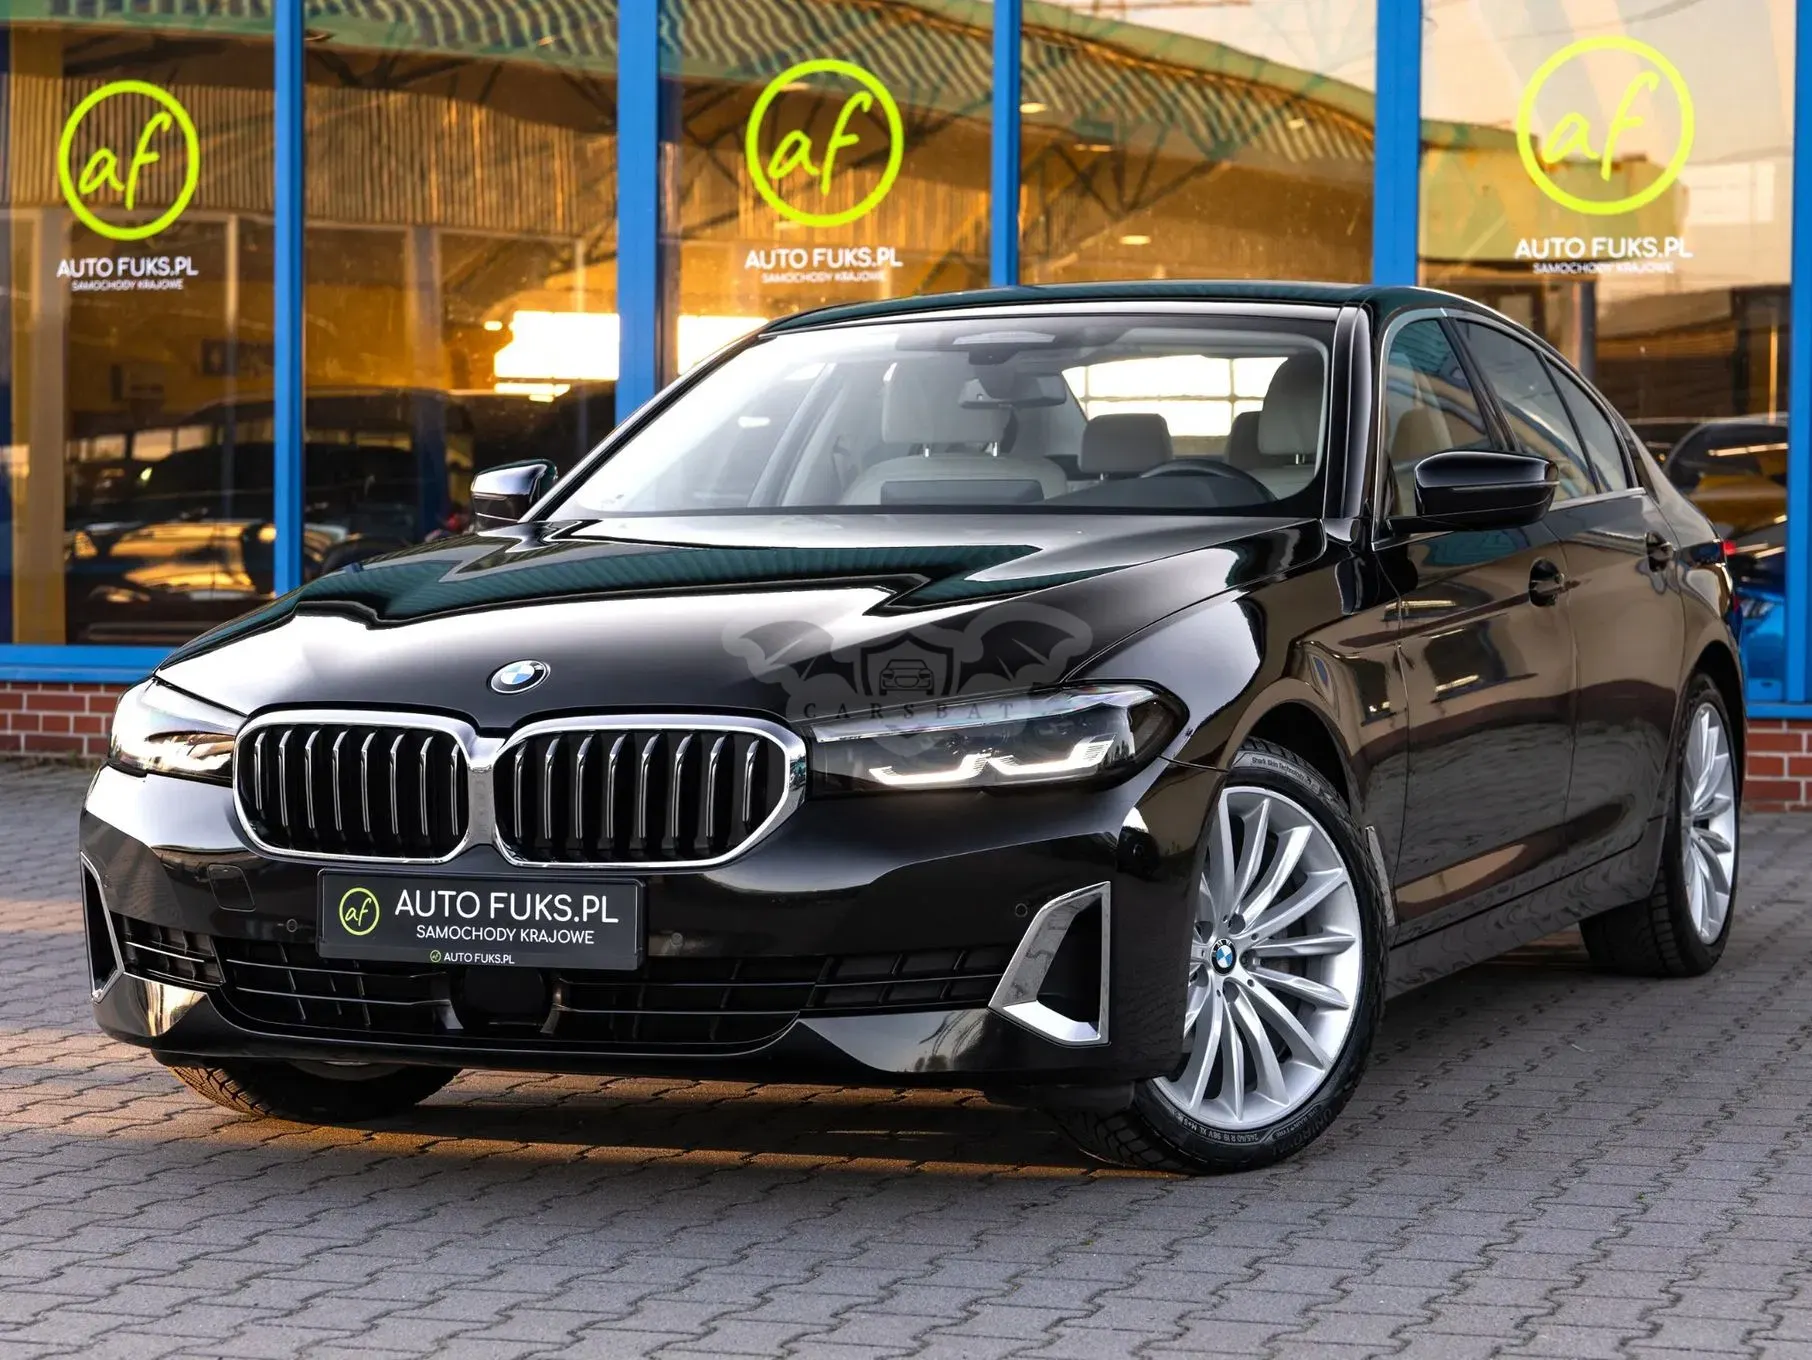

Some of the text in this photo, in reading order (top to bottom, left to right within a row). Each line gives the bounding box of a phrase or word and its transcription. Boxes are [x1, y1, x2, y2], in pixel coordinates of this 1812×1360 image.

[1543, 70, 1660, 182] af
[767, 91, 872, 196] af
[78, 111, 172, 211] af
[744, 247, 904, 270] AUTO FUKS.PL
[1514, 236, 1693, 259] AUTO FUKS.PL
[57, 256, 199, 278] AUTO FUKS.PL
[761, 270, 886, 284] SAMOCHODY KRAJOWE
[1532, 262, 1612, 275] SAMOCHODY
[71, 278, 184, 292] SAMOCHODY KRAJOWE
[345, 897, 372, 927] af
[394, 889, 619, 923] AUTO FUKS.PL
[416, 925, 595, 945] SAMOCHODY KRAJOWE
[443, 952, 515, 965] AUTO FUKS.PL
[1183, 1119, 1198, 1131] M+S
